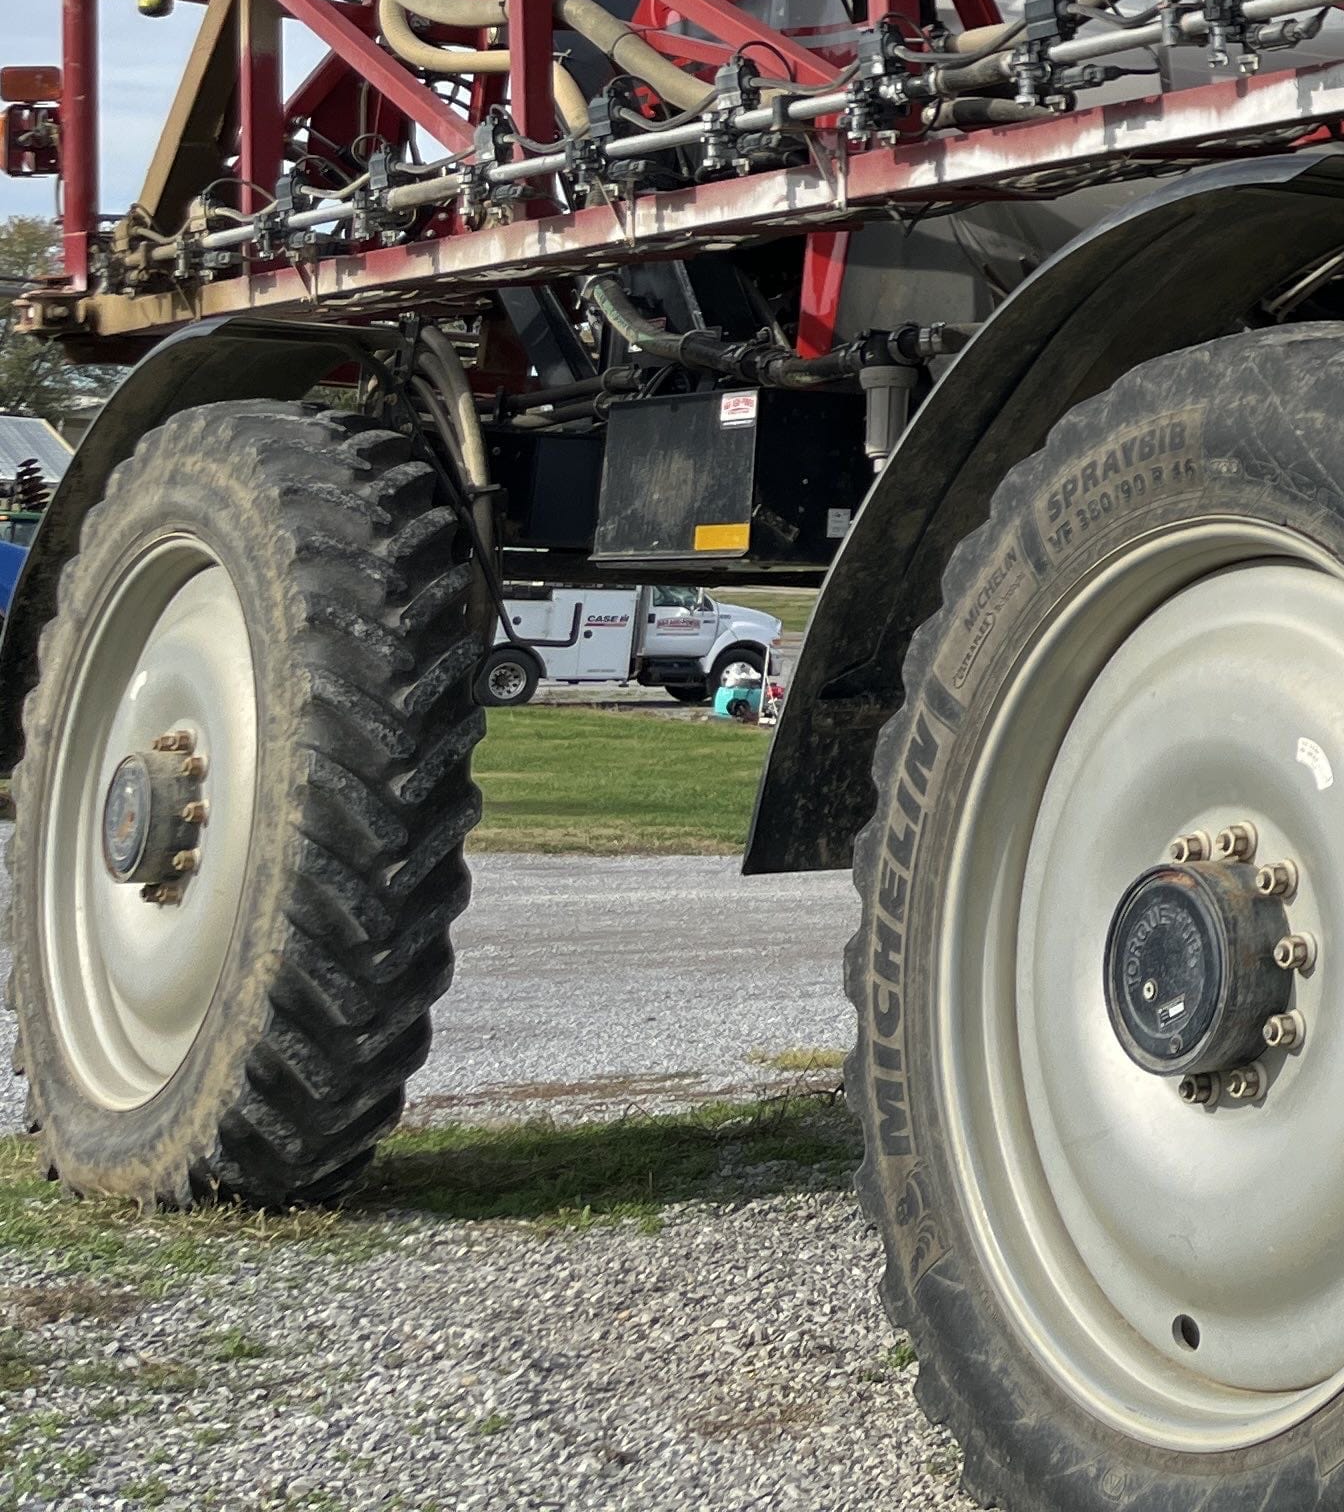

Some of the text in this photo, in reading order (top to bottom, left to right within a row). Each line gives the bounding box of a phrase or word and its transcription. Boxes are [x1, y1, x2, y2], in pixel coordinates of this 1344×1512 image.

[1046, 422, 1188, 524] SPRAYBIB
[587, 614, 617, 623] CASE
[963, 546, 1019, 633] MICHELIN
[872, 709, 941, 1156] MICHELIN
